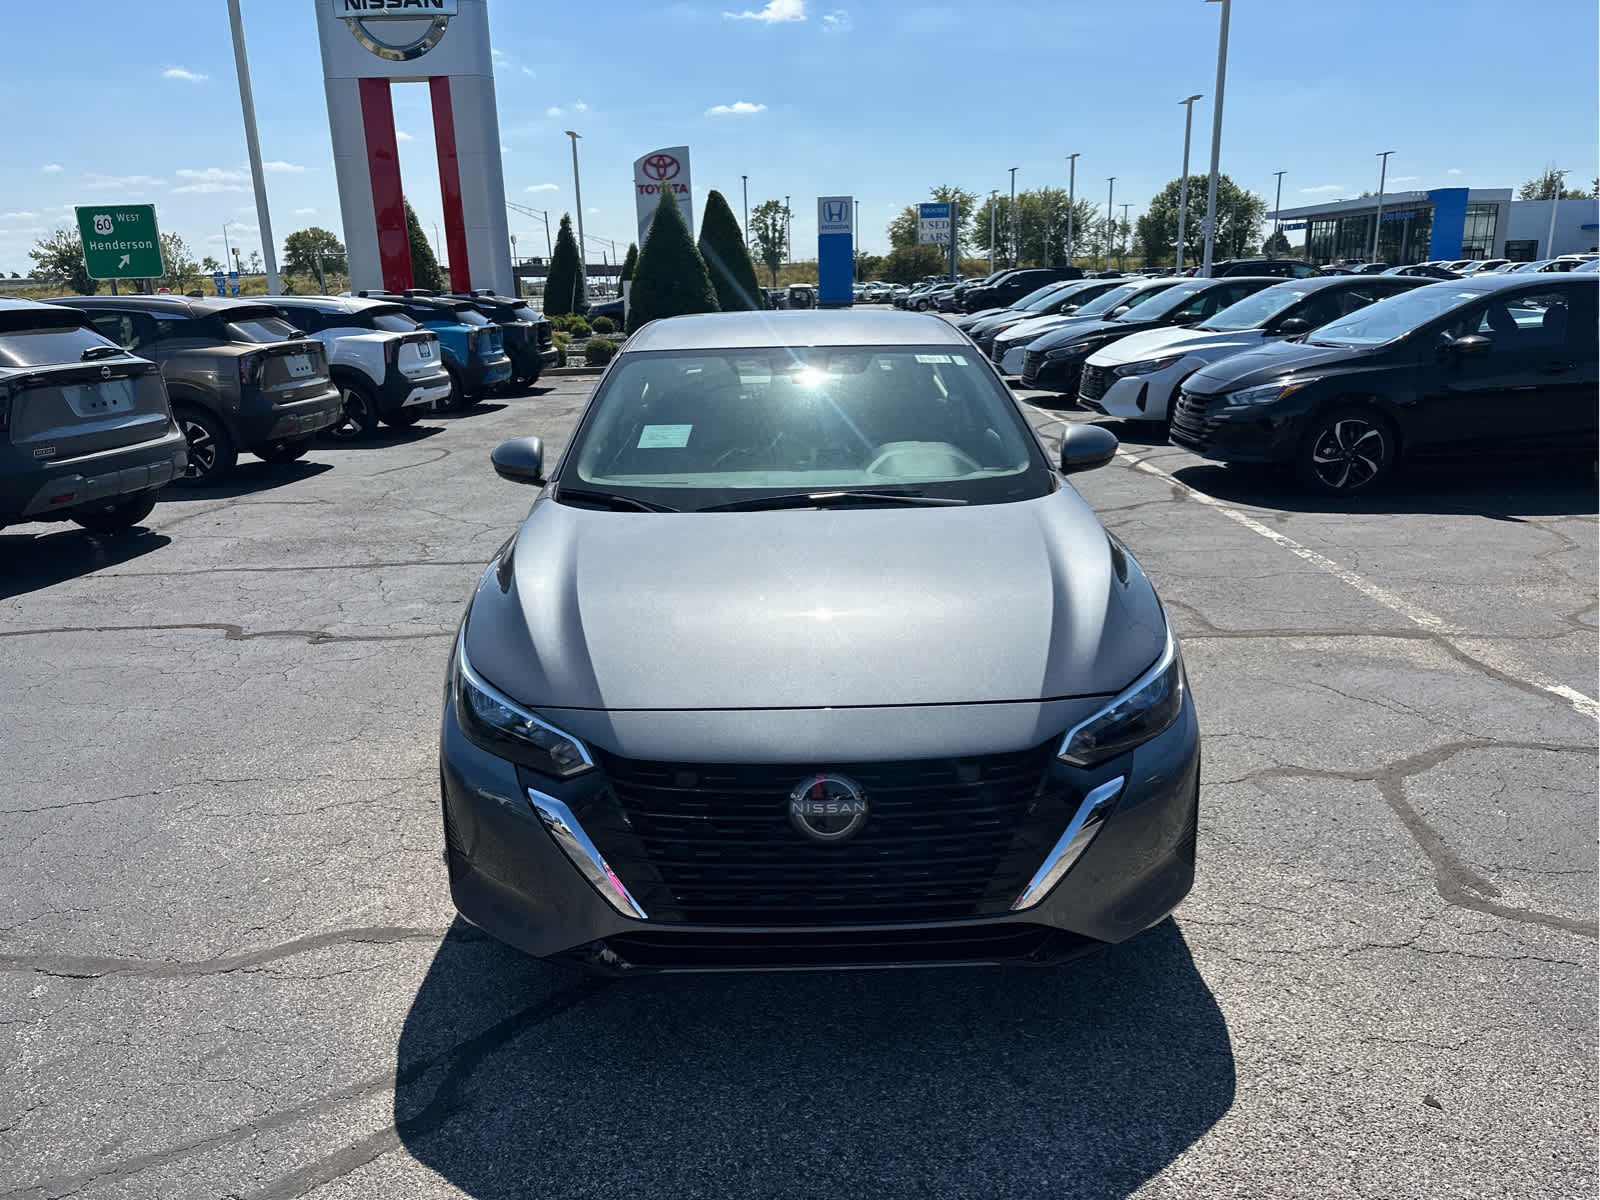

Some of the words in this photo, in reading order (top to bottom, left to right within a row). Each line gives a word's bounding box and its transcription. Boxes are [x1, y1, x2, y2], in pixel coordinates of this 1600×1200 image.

[637, 183, 689, 195] TOYTA
[96, 218, 112, 231] 60
[920, 220, 950, 230] USED
[920, 232, 950, 242] CARS
[89, 240, 153, 251] Henderson
[791, 802, 866, 814] NISSAN
